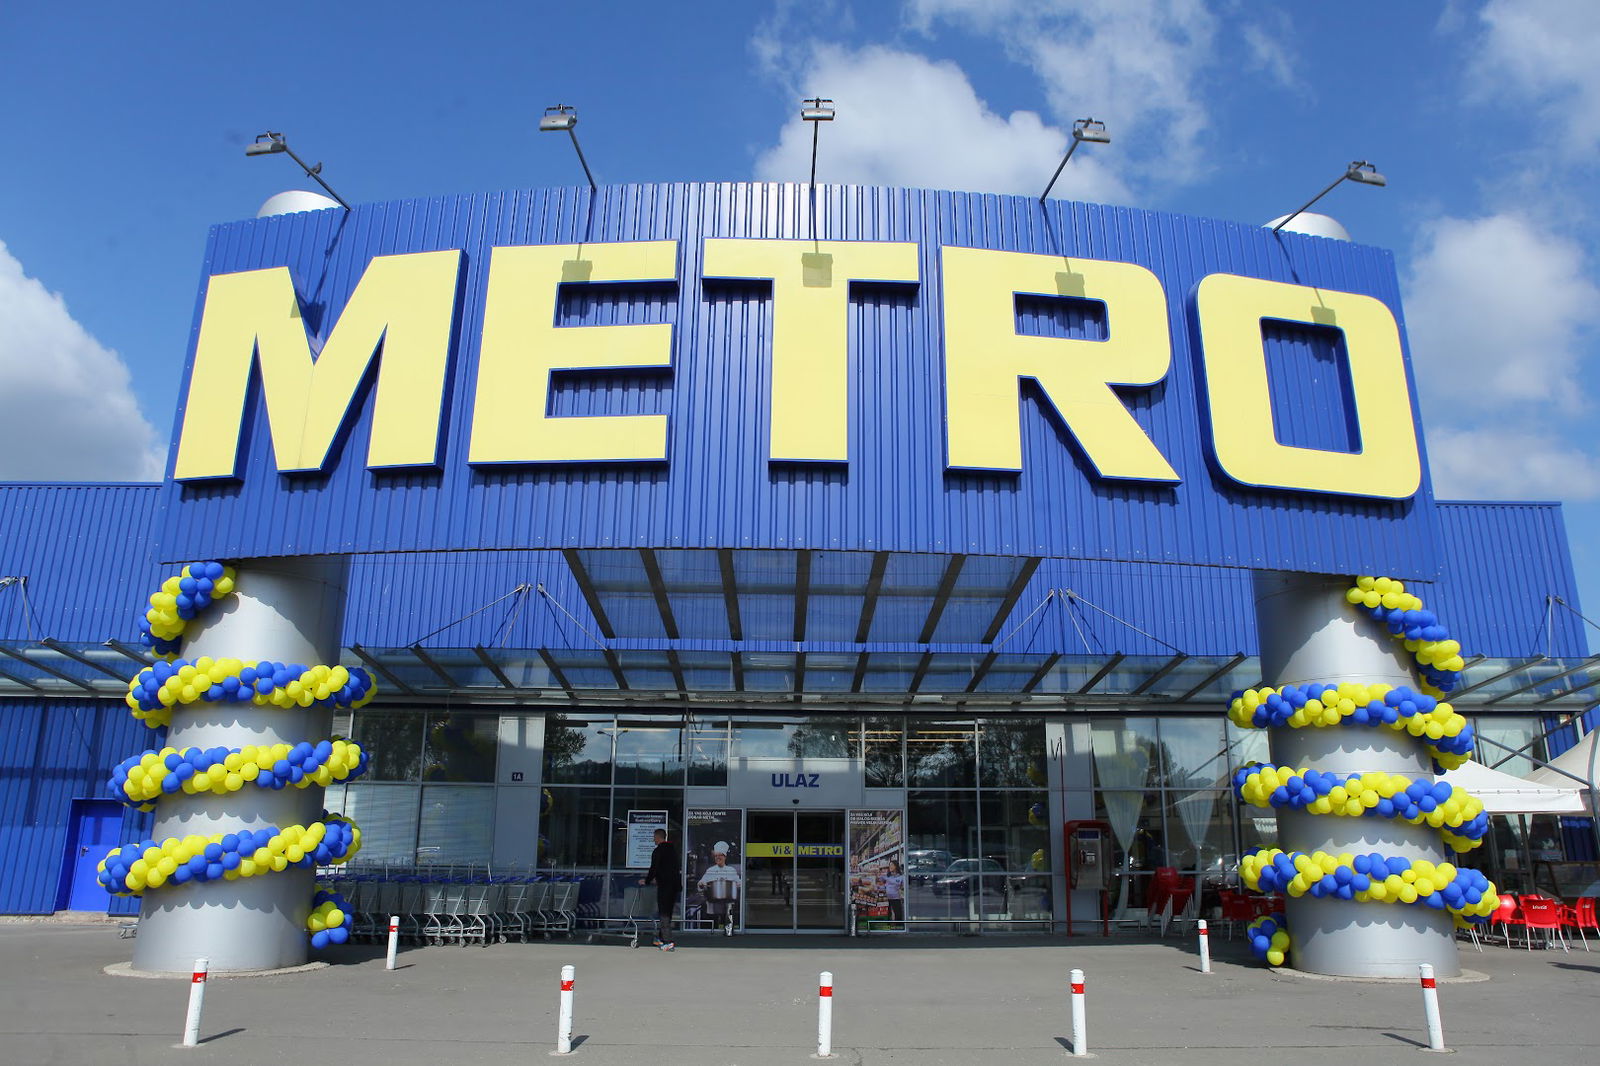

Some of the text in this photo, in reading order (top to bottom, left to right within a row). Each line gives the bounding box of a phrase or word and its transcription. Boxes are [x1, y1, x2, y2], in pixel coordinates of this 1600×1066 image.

[174, 239, 1421, 500] METRO
[513, 773, 522, 781] 1A
[771, 773, 820, 788] ULAZ
[772, 845, 843, 856] Vi & METRO
